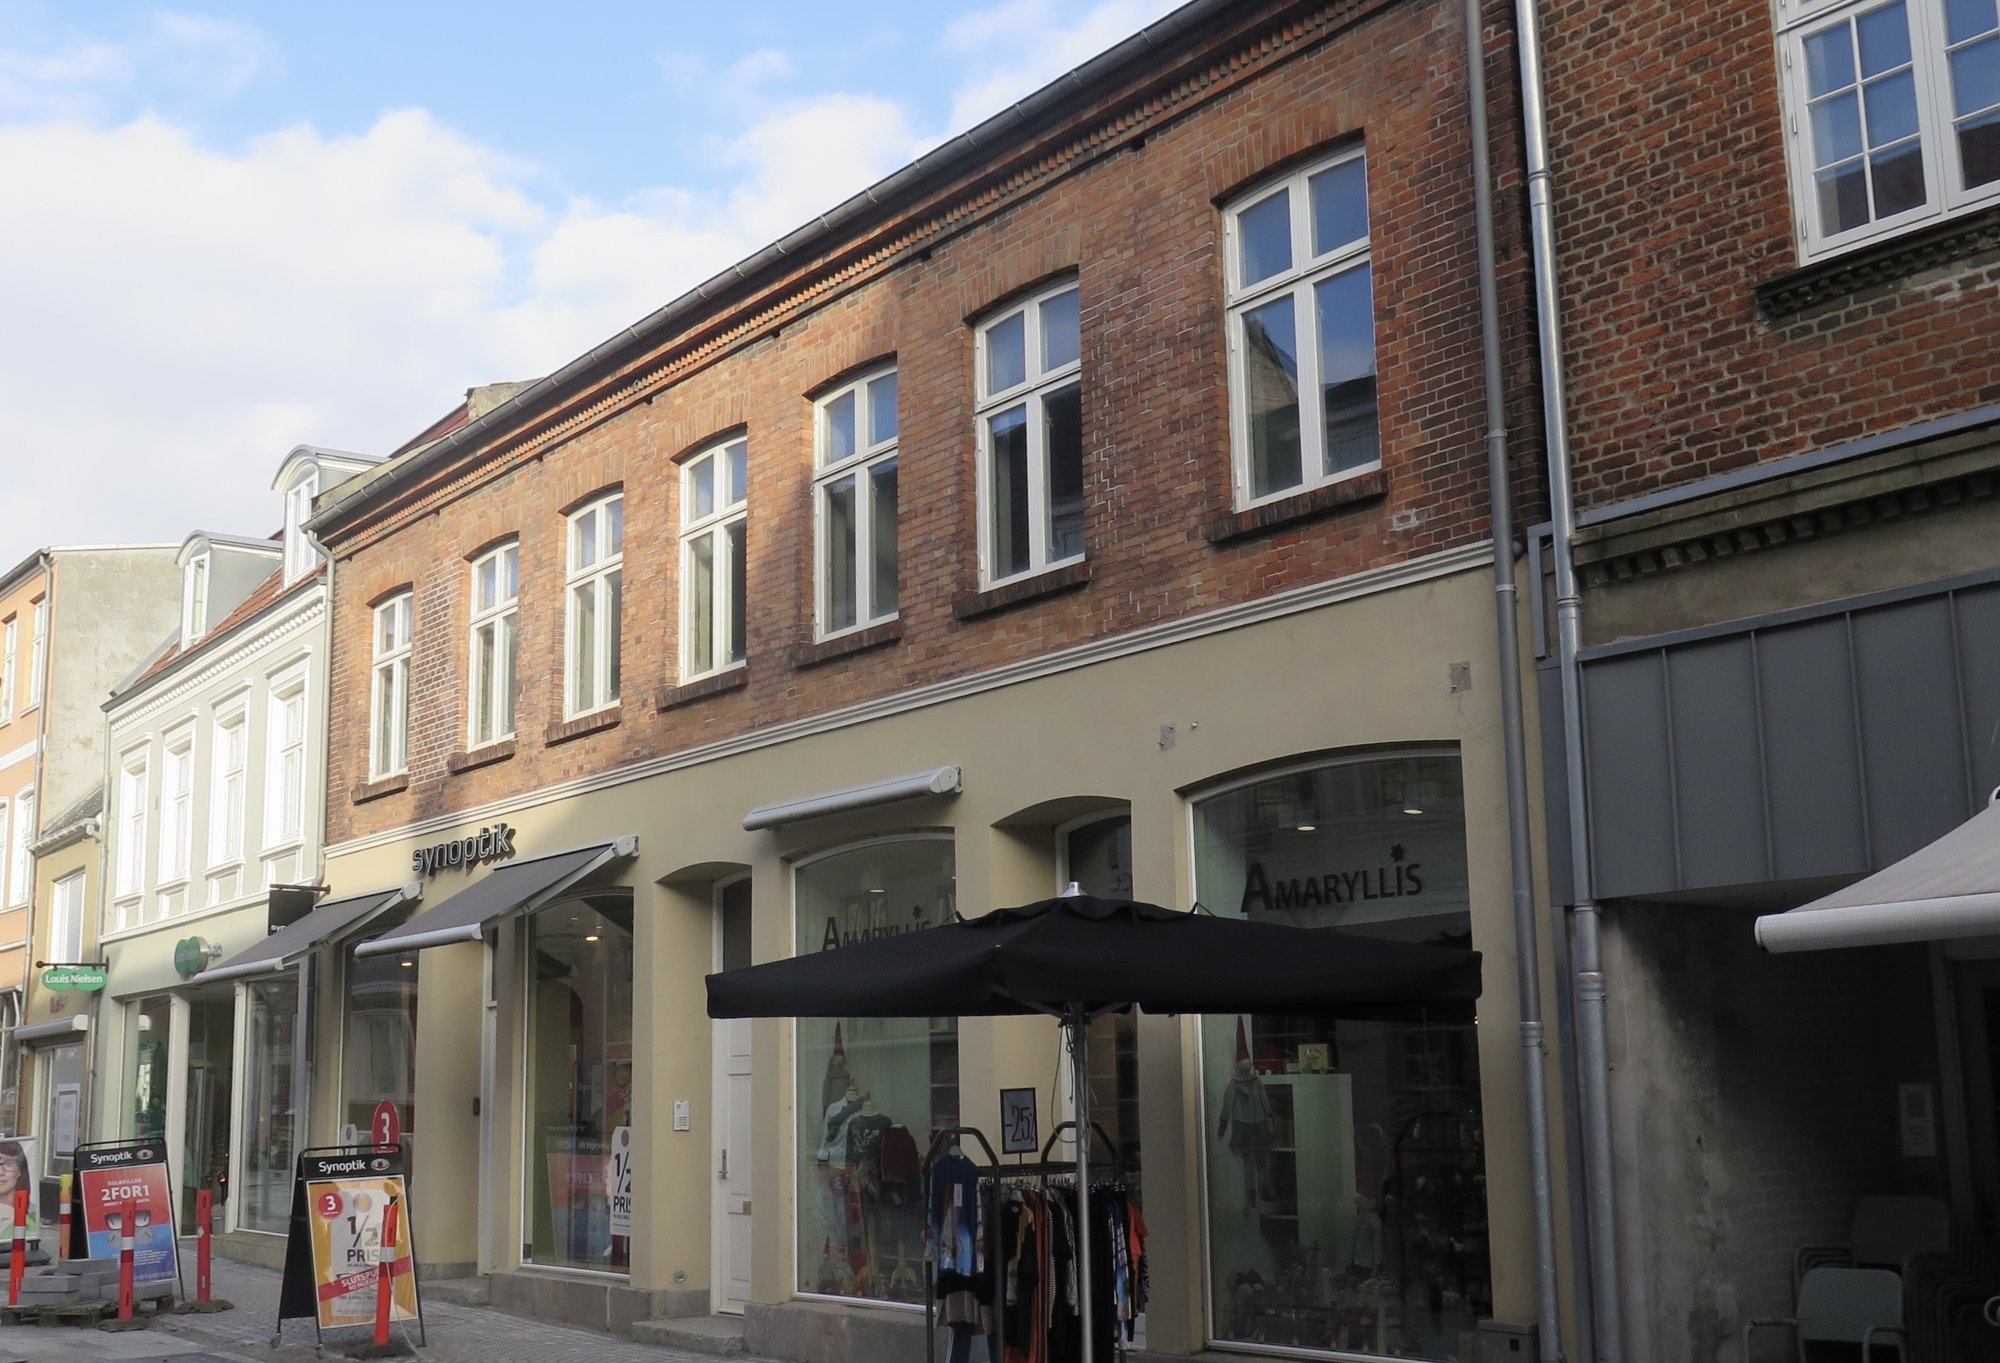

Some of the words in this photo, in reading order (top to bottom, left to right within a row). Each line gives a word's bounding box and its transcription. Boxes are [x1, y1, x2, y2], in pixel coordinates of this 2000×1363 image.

[412, 823, 514, 877] synoptik
[45, 974, 70, 983] Louis
[71, 974, 103, 983] Nielsen
[381, 1112, 390, 1149] 3
[90, 1151, 133, 1164] Synoptik
[318, 1160, 366, 1174] Synoptik
[101, 1185, 150, 1201] 2FOR1
[325, 1195, 337, 1211] 3
[347, 1249, 380, 1262] PRIS
